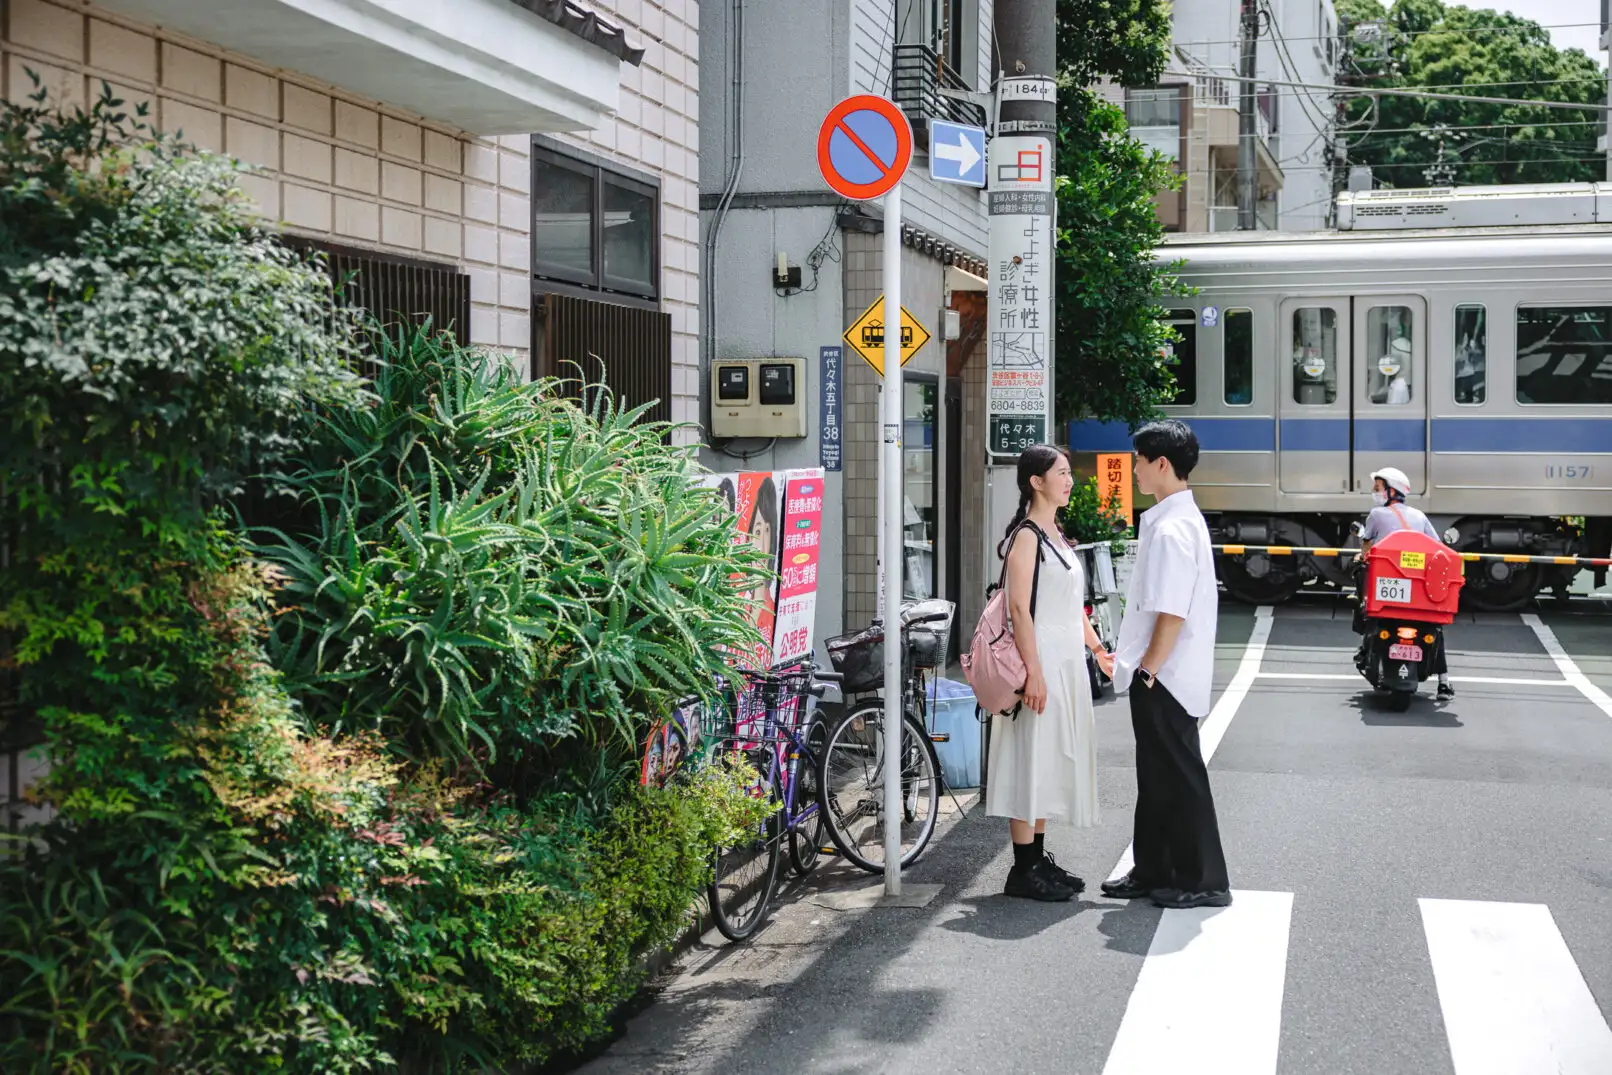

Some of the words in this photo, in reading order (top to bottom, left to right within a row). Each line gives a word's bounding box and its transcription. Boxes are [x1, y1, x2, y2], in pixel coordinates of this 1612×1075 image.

[1016, 84, 1038, 94] 184
[998, 260, 1019, 329] 診療所
[825, 358, 837, 426] 代々木五丁目
[991, 401, 1045, 411] 6804-8839
[823, 427, 839, 440] 38
[1000, 423, 1037, 435] 代々木
[1001, 437, 1035, 449] 5-38
[826, 460, 836, 468] 38
[1550, 466, 1590, 478] 1157
[1107, 458, 1122, 509] 踏切注
[1379, 578, 1400, 586] 代々木
[1380, 586, 1406, 599] 601
[779, 625, 808, 659] 公明党
